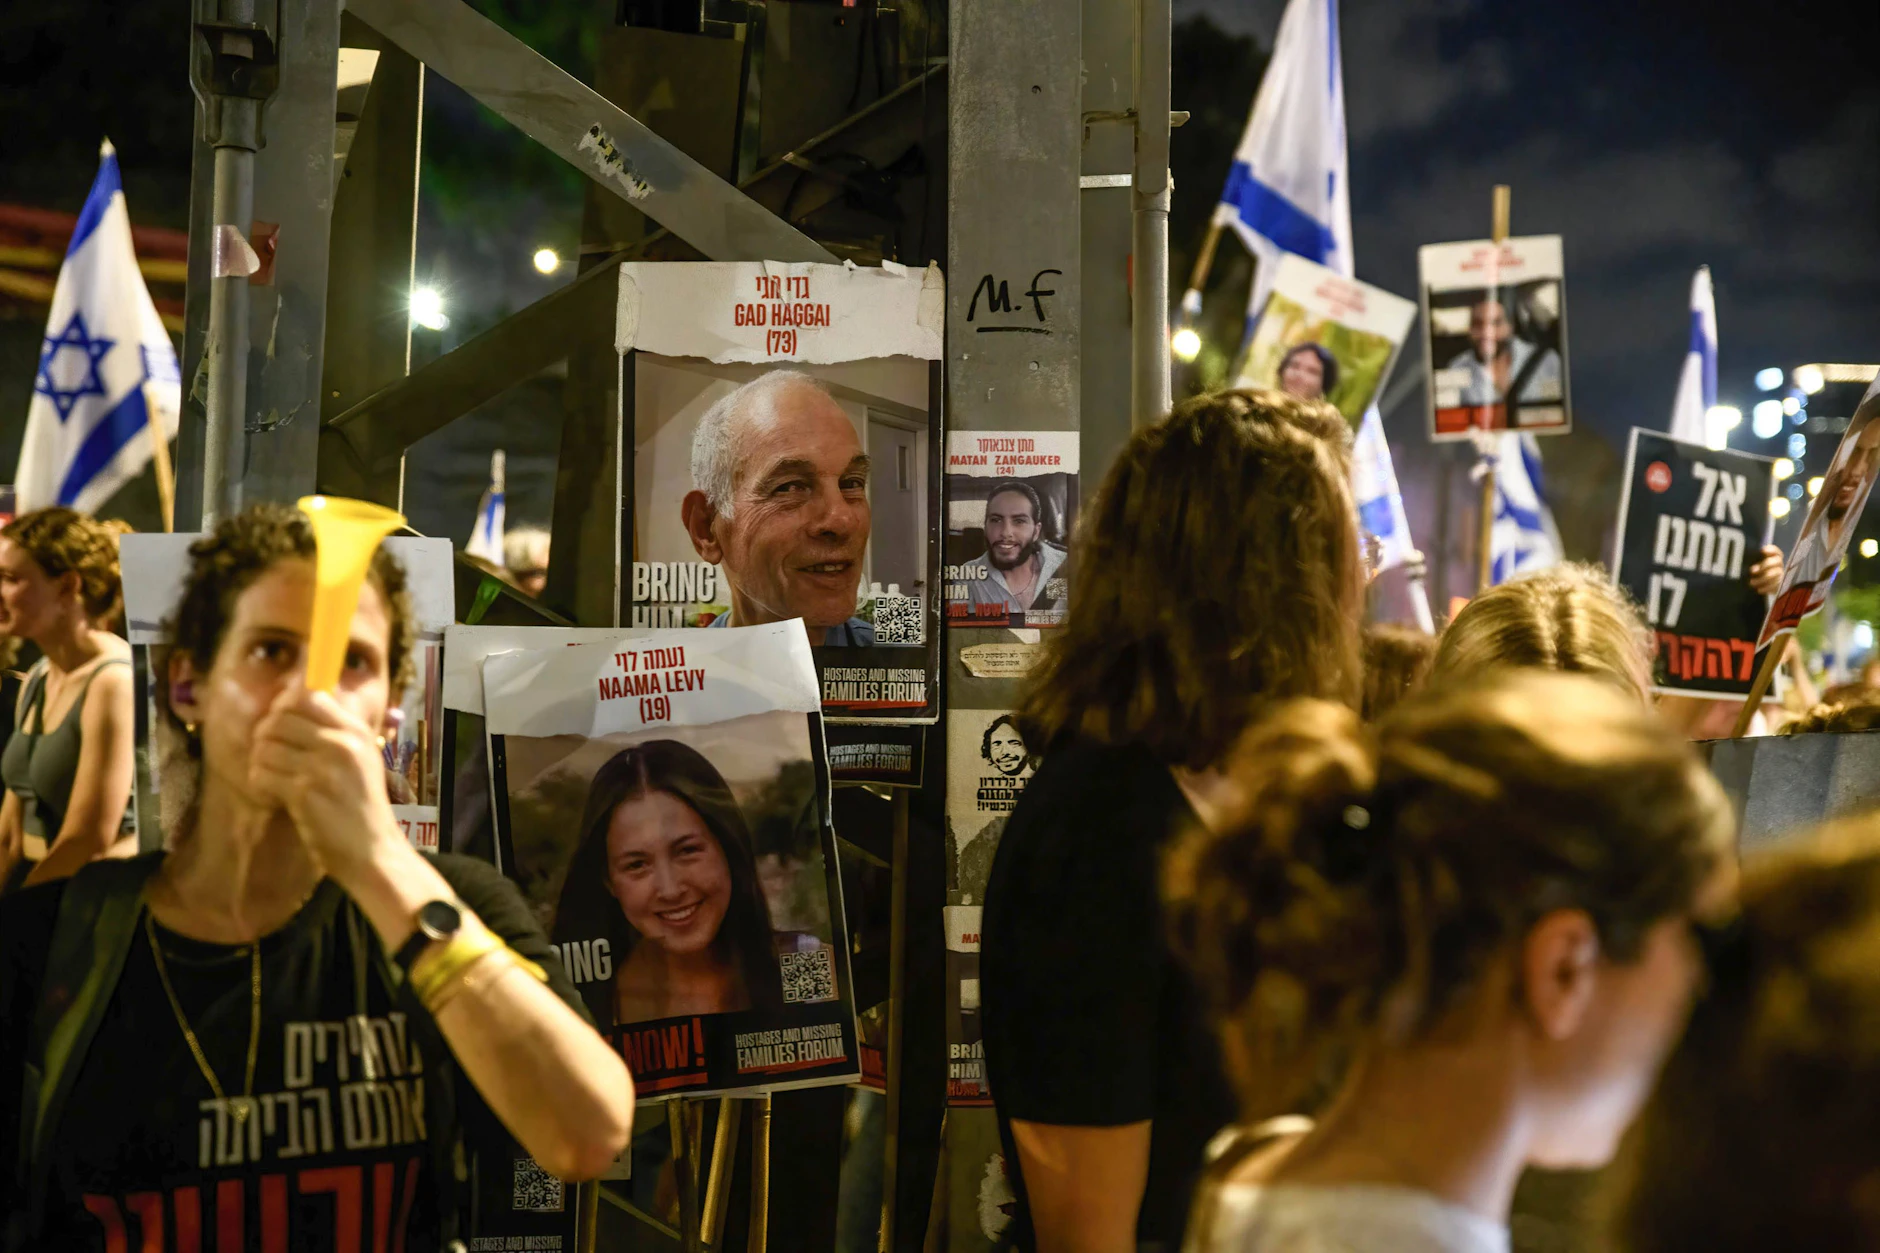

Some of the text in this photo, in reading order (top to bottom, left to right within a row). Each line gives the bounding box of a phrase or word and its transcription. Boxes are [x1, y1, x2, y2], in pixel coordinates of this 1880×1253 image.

[786, 276, 810, 299] גדי
[735, 302, 830, 327] GAD HAGGAI
[766, 329, 797, 356] (73)
[1017, 438, 1035, 453] מתן
[949, 455, 1061, 466] MATAN ZANGAUKER
[996, 466, 1015, 475] (24)
[1691, 461, 1747, 525] אל
[1653, 513, 1746, 580] תתנו
[632, 561, 716, 603] BRING
[1647, 571, 1687, 628] לו
[614, 646, 686, 673] נעמה לוי
[599, 669, 705, 701] NAAMA LEVY
[823, 667, 926, 683] HOSTAGES AND MISSING
[823, 681, 926, 703] FAMILIES FORUM
[639, 694, 671, 724] (19)
[829, 743, 912, 756] HOSTAGES AND MISSING
[829, 754, 911, 772] FAMILIES FORUM
[979, 775, 1016, 788] קלדרון
[549, 938, 612, 984] ING
[622, 1017, 706, 1076] NOW!
[735, 1022, 842, 1048] HOSTAGES AND MISSING
[737, 1037, 844, 1070] FAMILIES FORUM
[950, 1063, 981, 1079] HIM
[199, 1086, 335, 1169] הביתה
[470, 1238, 504, 1252] STAGES
